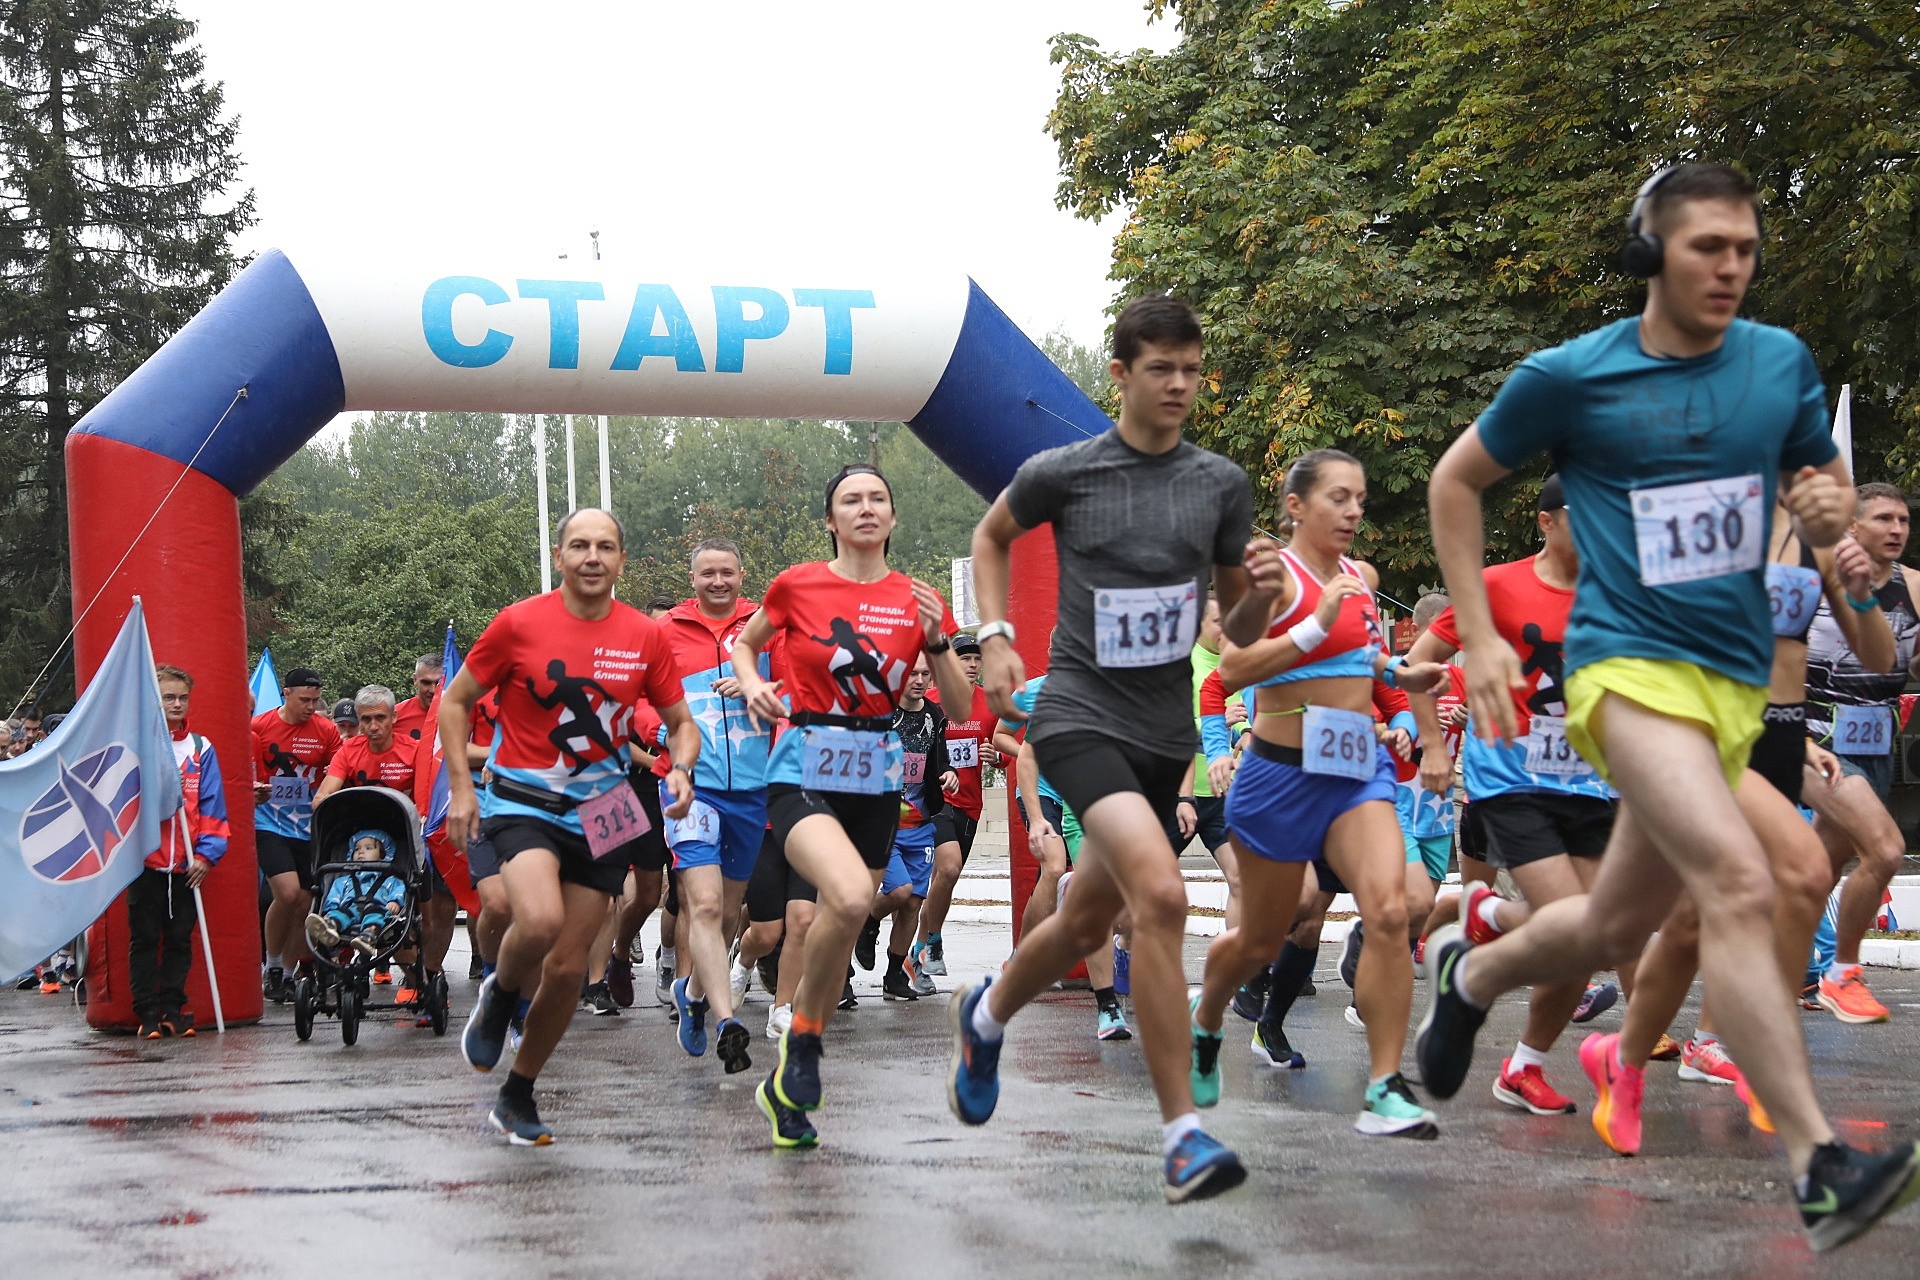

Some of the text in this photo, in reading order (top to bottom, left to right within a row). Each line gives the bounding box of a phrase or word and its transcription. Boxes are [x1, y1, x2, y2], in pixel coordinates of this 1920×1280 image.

[422, 276, 876, 375] СТАРТ
[1664, 508, 1744, 558] 130
[859, 603, 906, 615] И звезды
[858, 624, 893, 635] ближе
[1118, 609, 1181, 648] 137
[593, 647, 640, 659] И звезды
[593, 670, 630, 682] ближе
[1763, 707, 1805, 723] PRO
[1845, 721, 1883, 743] 228
[952, 747, 971, 761] 33
[1320, 728, 1367, 764] 269
[1542, 733, 1584, 761] 13
[817, 748, 872, 779] 275
[275, 785, 302, 798] 224
[594, 799, 638, 839] 314
